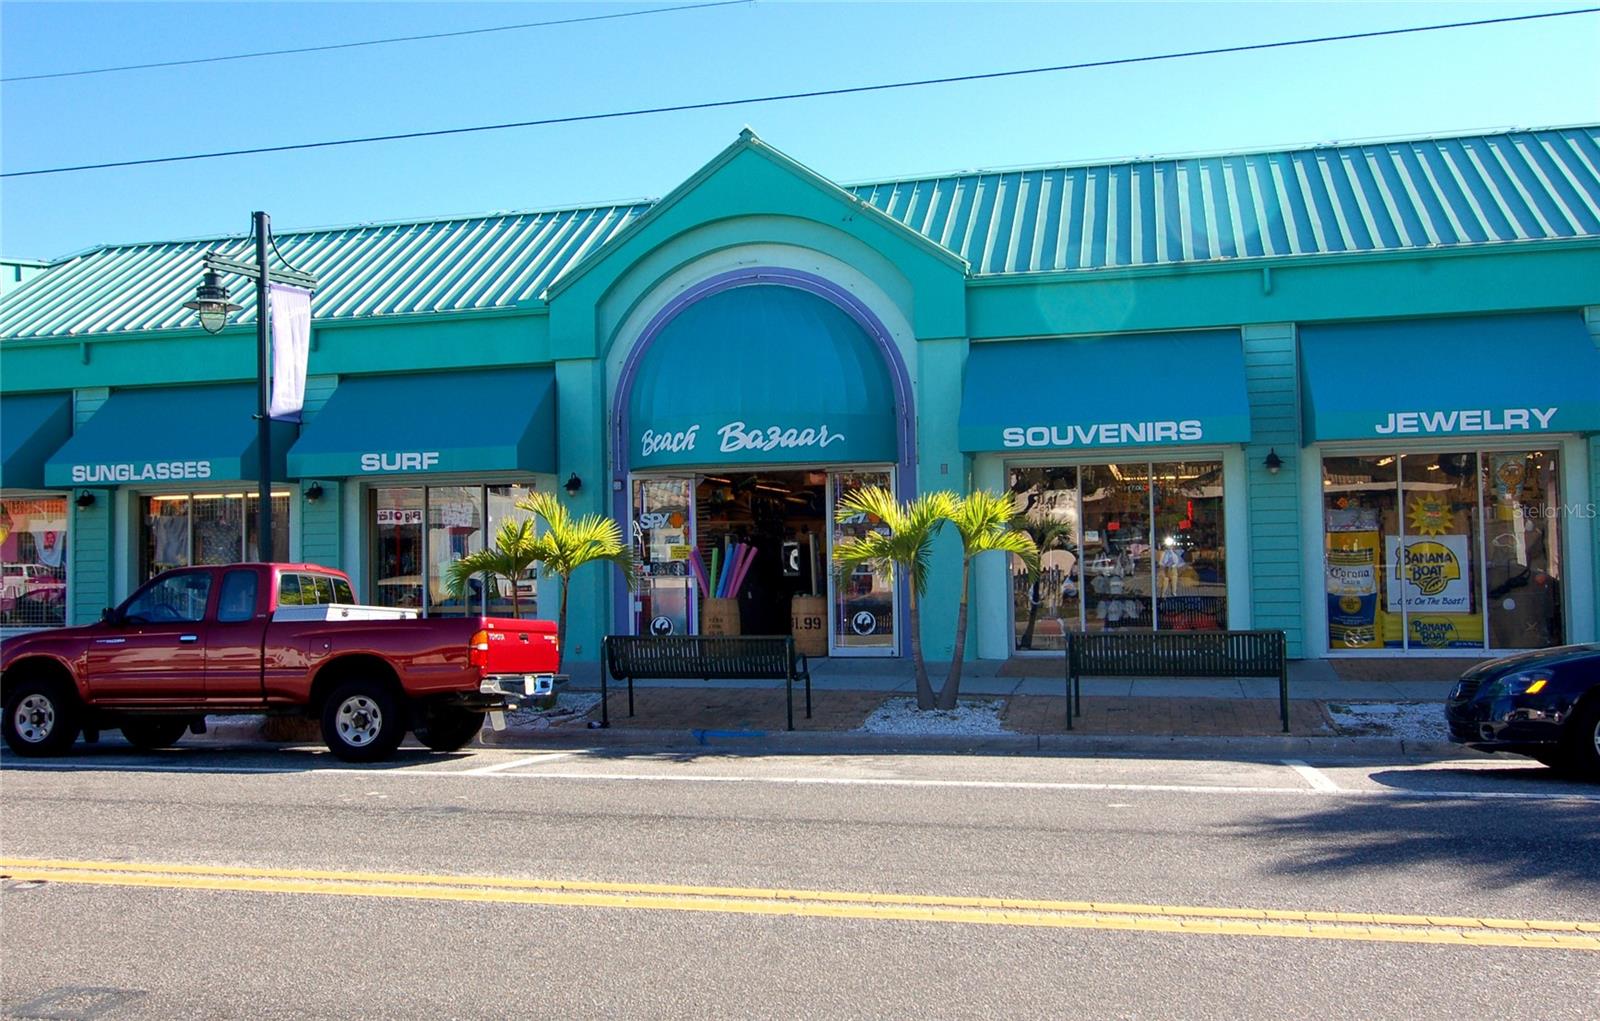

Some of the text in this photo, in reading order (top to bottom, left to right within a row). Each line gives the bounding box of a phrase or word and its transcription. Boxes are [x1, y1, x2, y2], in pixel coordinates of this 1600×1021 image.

[1375, 407, 1557, 434] JEWELRY
[641, 421, 845, 457] Beach Bazaar
[1002, 420, 1203, 447] SOUVENIRS
[72, 461, 211, 482] SUNGLASSES
[360, 452, 440, 472] SURF
[640, 512, 670, 529] SPY
[1401, 547, 1453, 566] BANANA
[1330, 567, 1370, 579] Corona
[1410, 564, 1445, 582] BOAT
[1412, 620, 1455, 633] BANANA
[1422, 631, 1447, 642] BOAT
